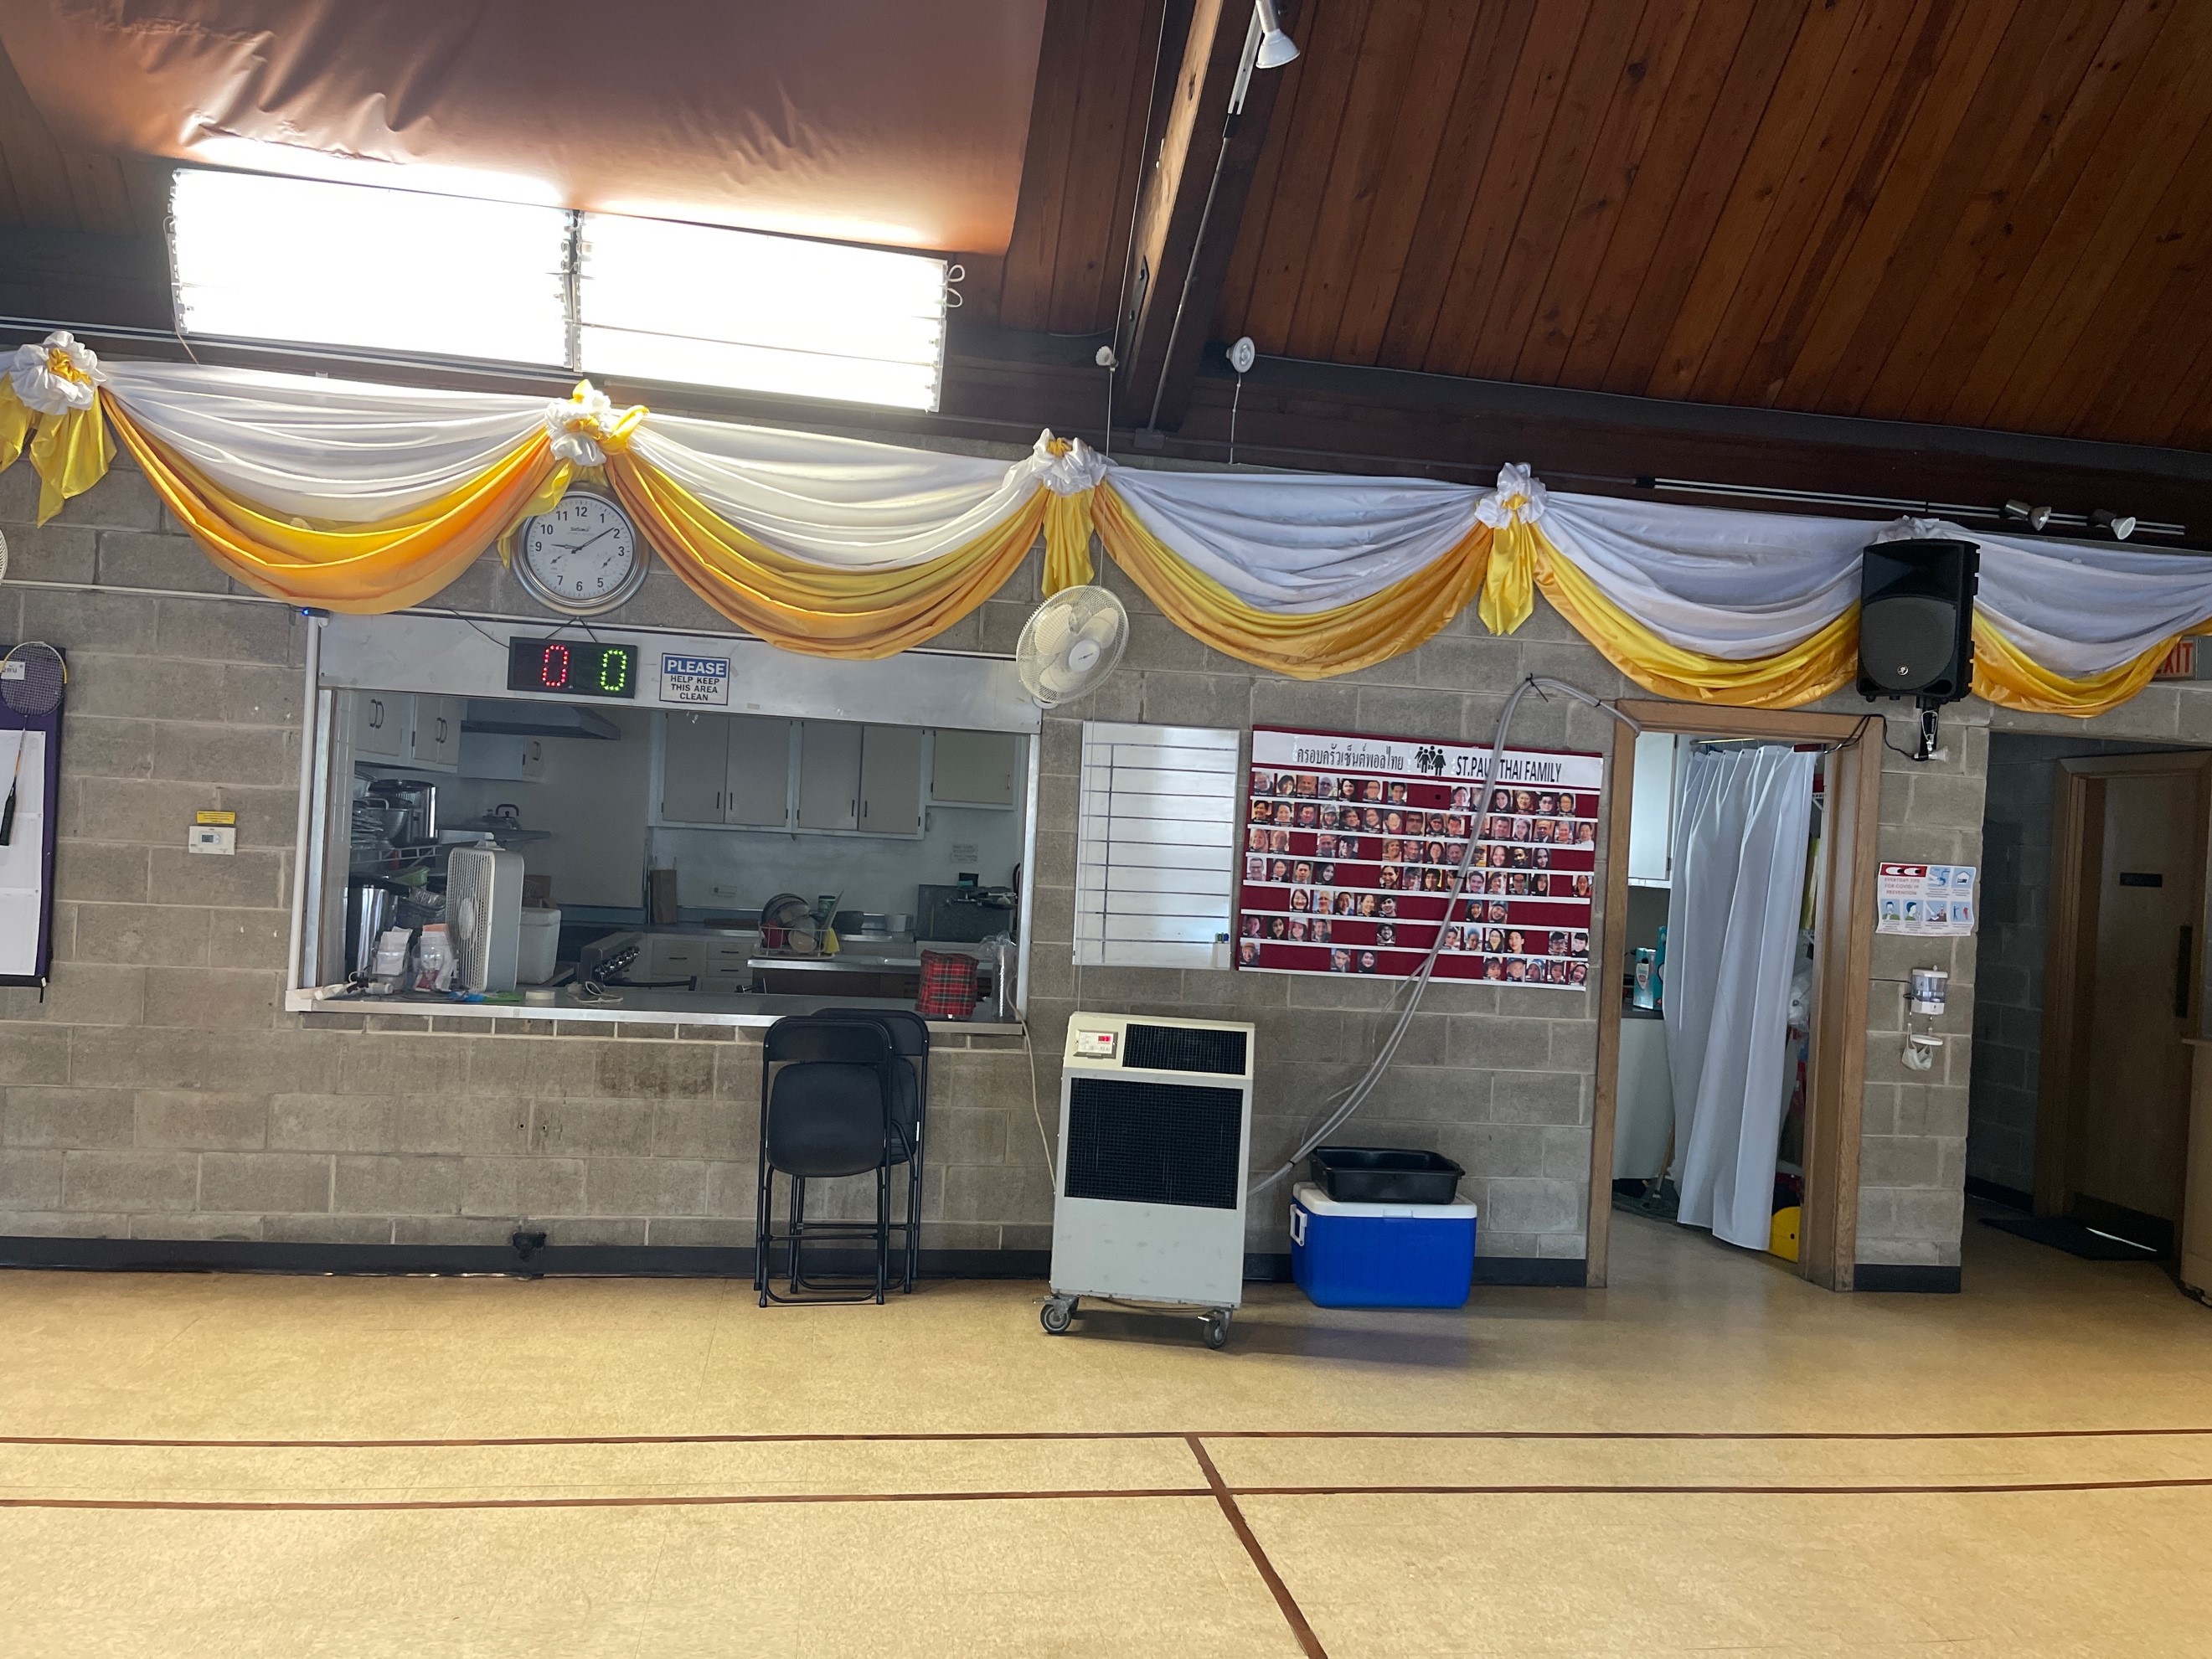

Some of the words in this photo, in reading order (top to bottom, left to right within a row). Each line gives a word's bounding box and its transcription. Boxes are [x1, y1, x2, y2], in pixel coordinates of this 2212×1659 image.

[556, 511, 568, 521] 11
[575, 507, 587, 517] 12
[600, 513, 605, 523] 1
[541, 524, 553, 534] 10
[613, 528, 620, 538] 2
[535, 542, 542, 551] 9
[618, 546, 625, 556] 3
[557, 575, 563, 585] 7
[597, 578, 603, 587] 5
[576, 581, 582, 591] 6
[2156, 642, 2193, 673] XIT
[543, 645, 569, 687] 0
[601, 650, 627, 691] 0
[668, 660, 725, 675] PLEASE
[670, 675, 694, 683] HELP
[697, 677, 719, 685] KEEP
[694, 685, 718, 693] AREA
[680, 692, 709, 701] CLEAN
[1500, 759, 1523, 780] THAI
[1524, 760, 1562, 783] FAMILY
